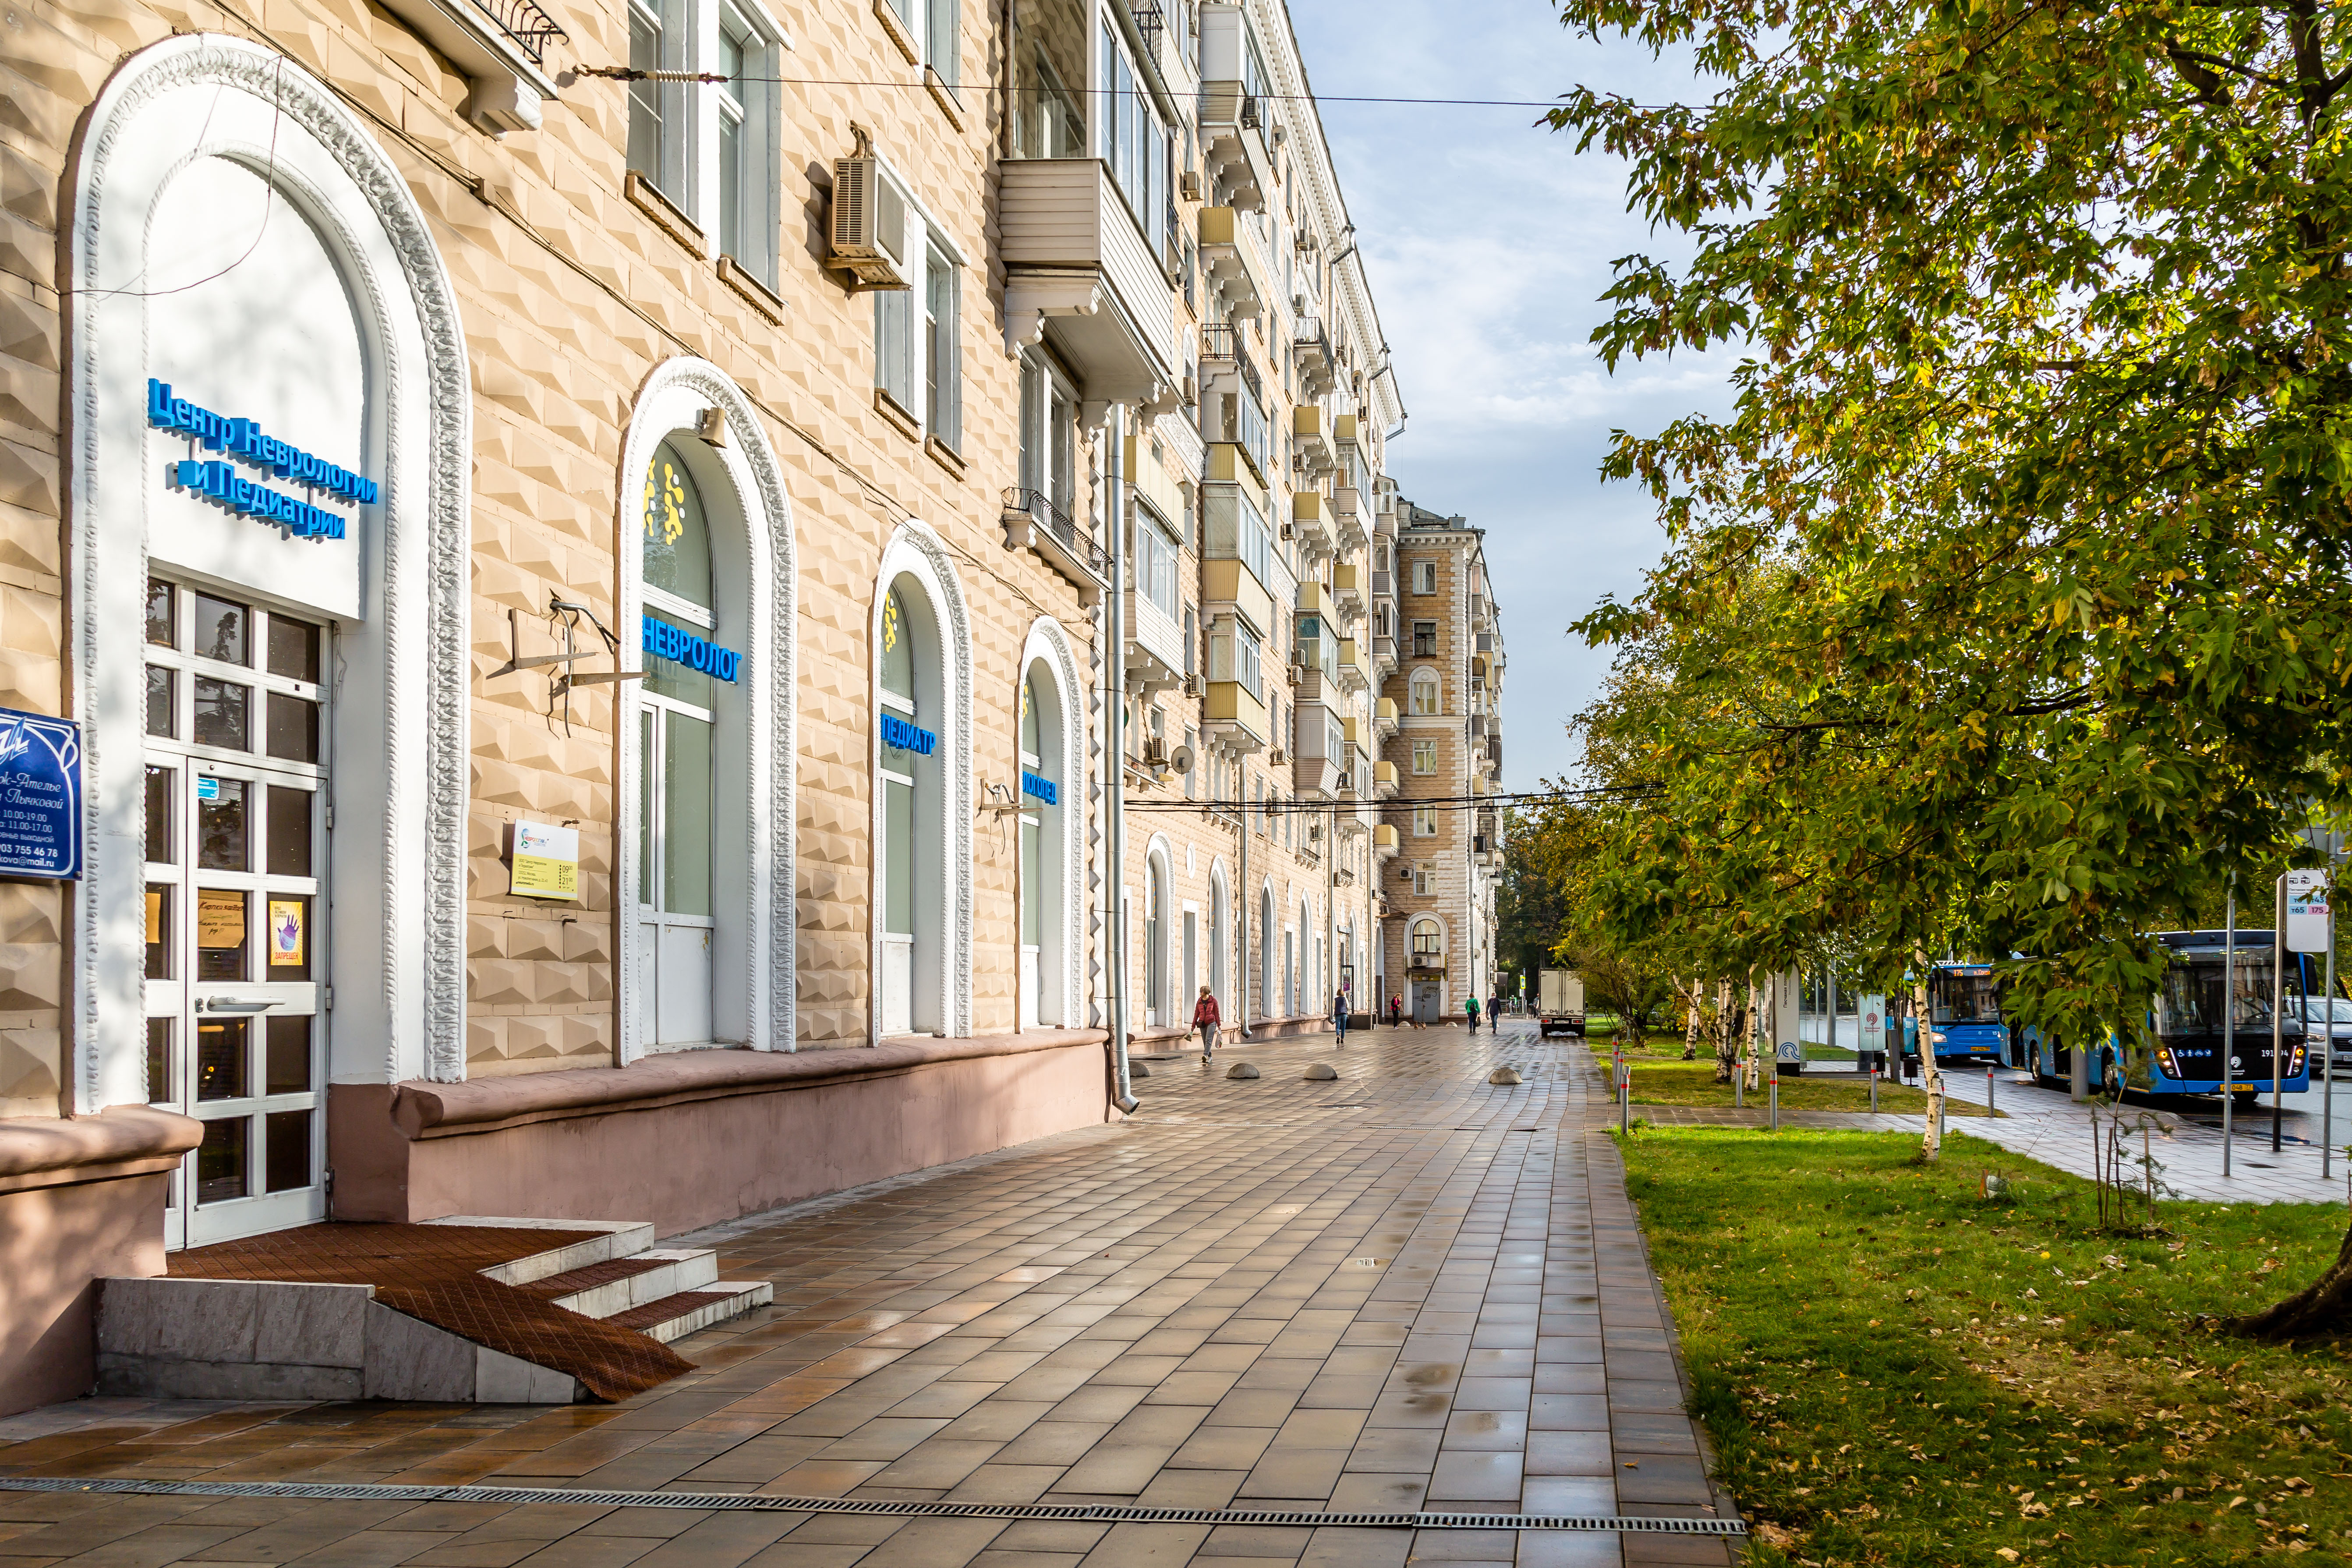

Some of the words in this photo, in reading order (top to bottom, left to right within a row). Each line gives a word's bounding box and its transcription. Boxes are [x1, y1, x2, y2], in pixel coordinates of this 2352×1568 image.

[148, 378, 235, 450] Центр
[230, 418, 378, 504] Неврологии
[178, 460, 209, 489] и
[202, 460, 345, 539] Педиатрии
[642, 614, 742, 682] НЕВРОЛОГ
[881, 714, 936, 755] ПЕДИАТР
[5, 788, 64, 809] Лычковой
[1023, 771, 1057, 805] ЛОГОПЕД
[4, 810, 47, 822] 10.00-19.00
[8, 821, 53, 833] 11.00-17.00
[15, 845, 32, 855] 755
[34, 847, 45, 856] 46
[47, 849, 58, 857] 78
[20, 834, 54, 843] выходной
